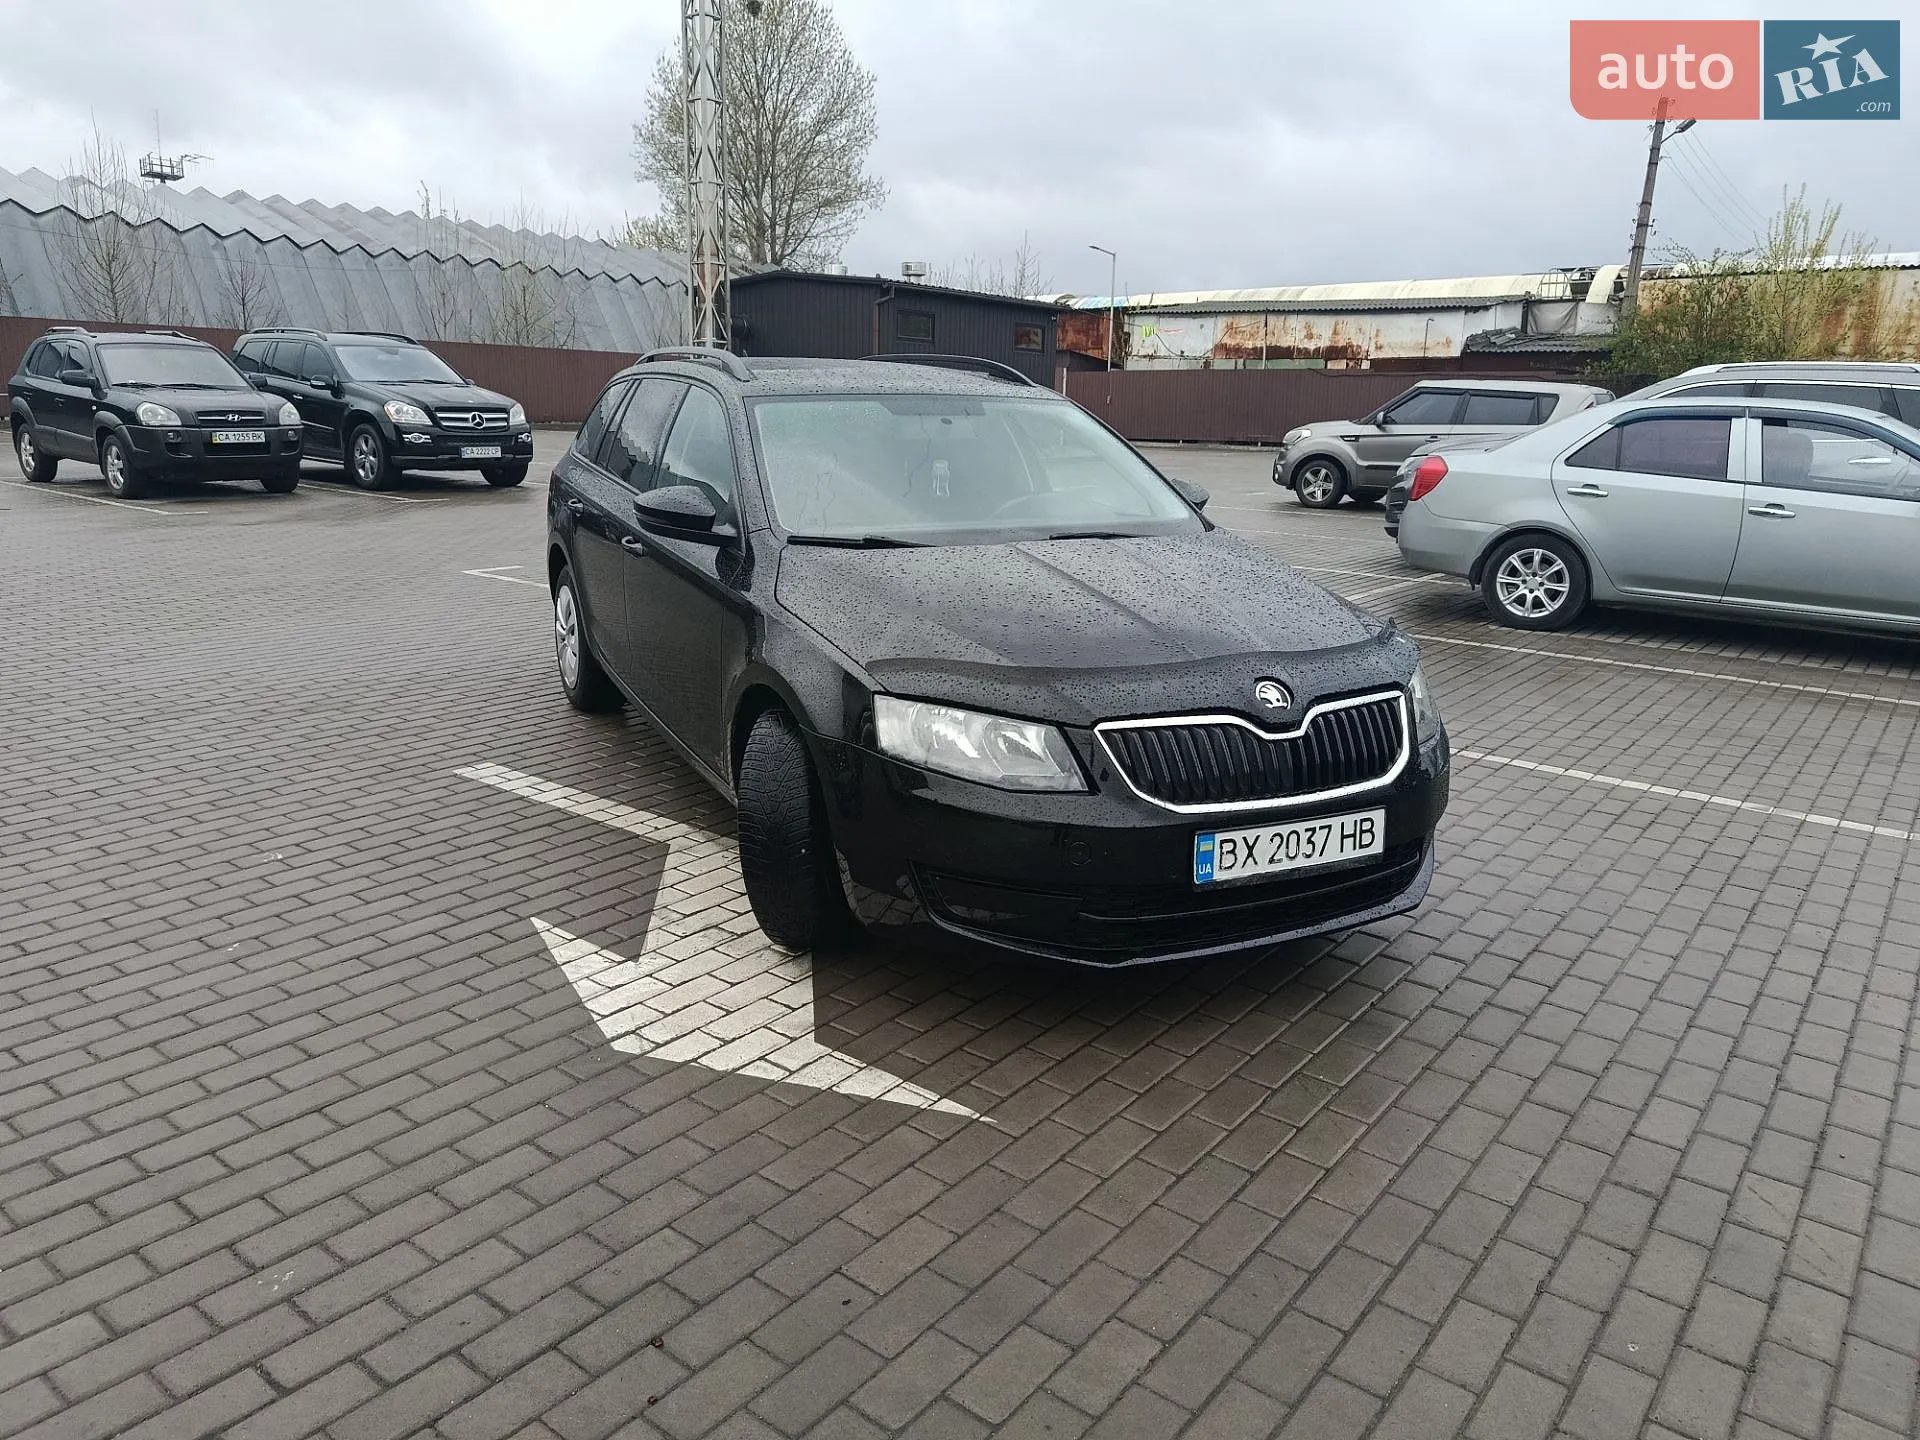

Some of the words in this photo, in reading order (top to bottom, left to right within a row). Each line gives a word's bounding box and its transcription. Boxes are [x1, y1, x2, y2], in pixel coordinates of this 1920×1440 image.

[217, 433, 230, 442] CA
[233, 433, 251, 442] 1255
[251, 432, 263, 441] BK
[476, 448, 490, 456] 2222
[1219, 835, 1260, 871] BX
[1268, 825, 1332, 865] 2037
[1340, 817, 1376, 853] HB
[1198, 863, 1212, 874] UA
